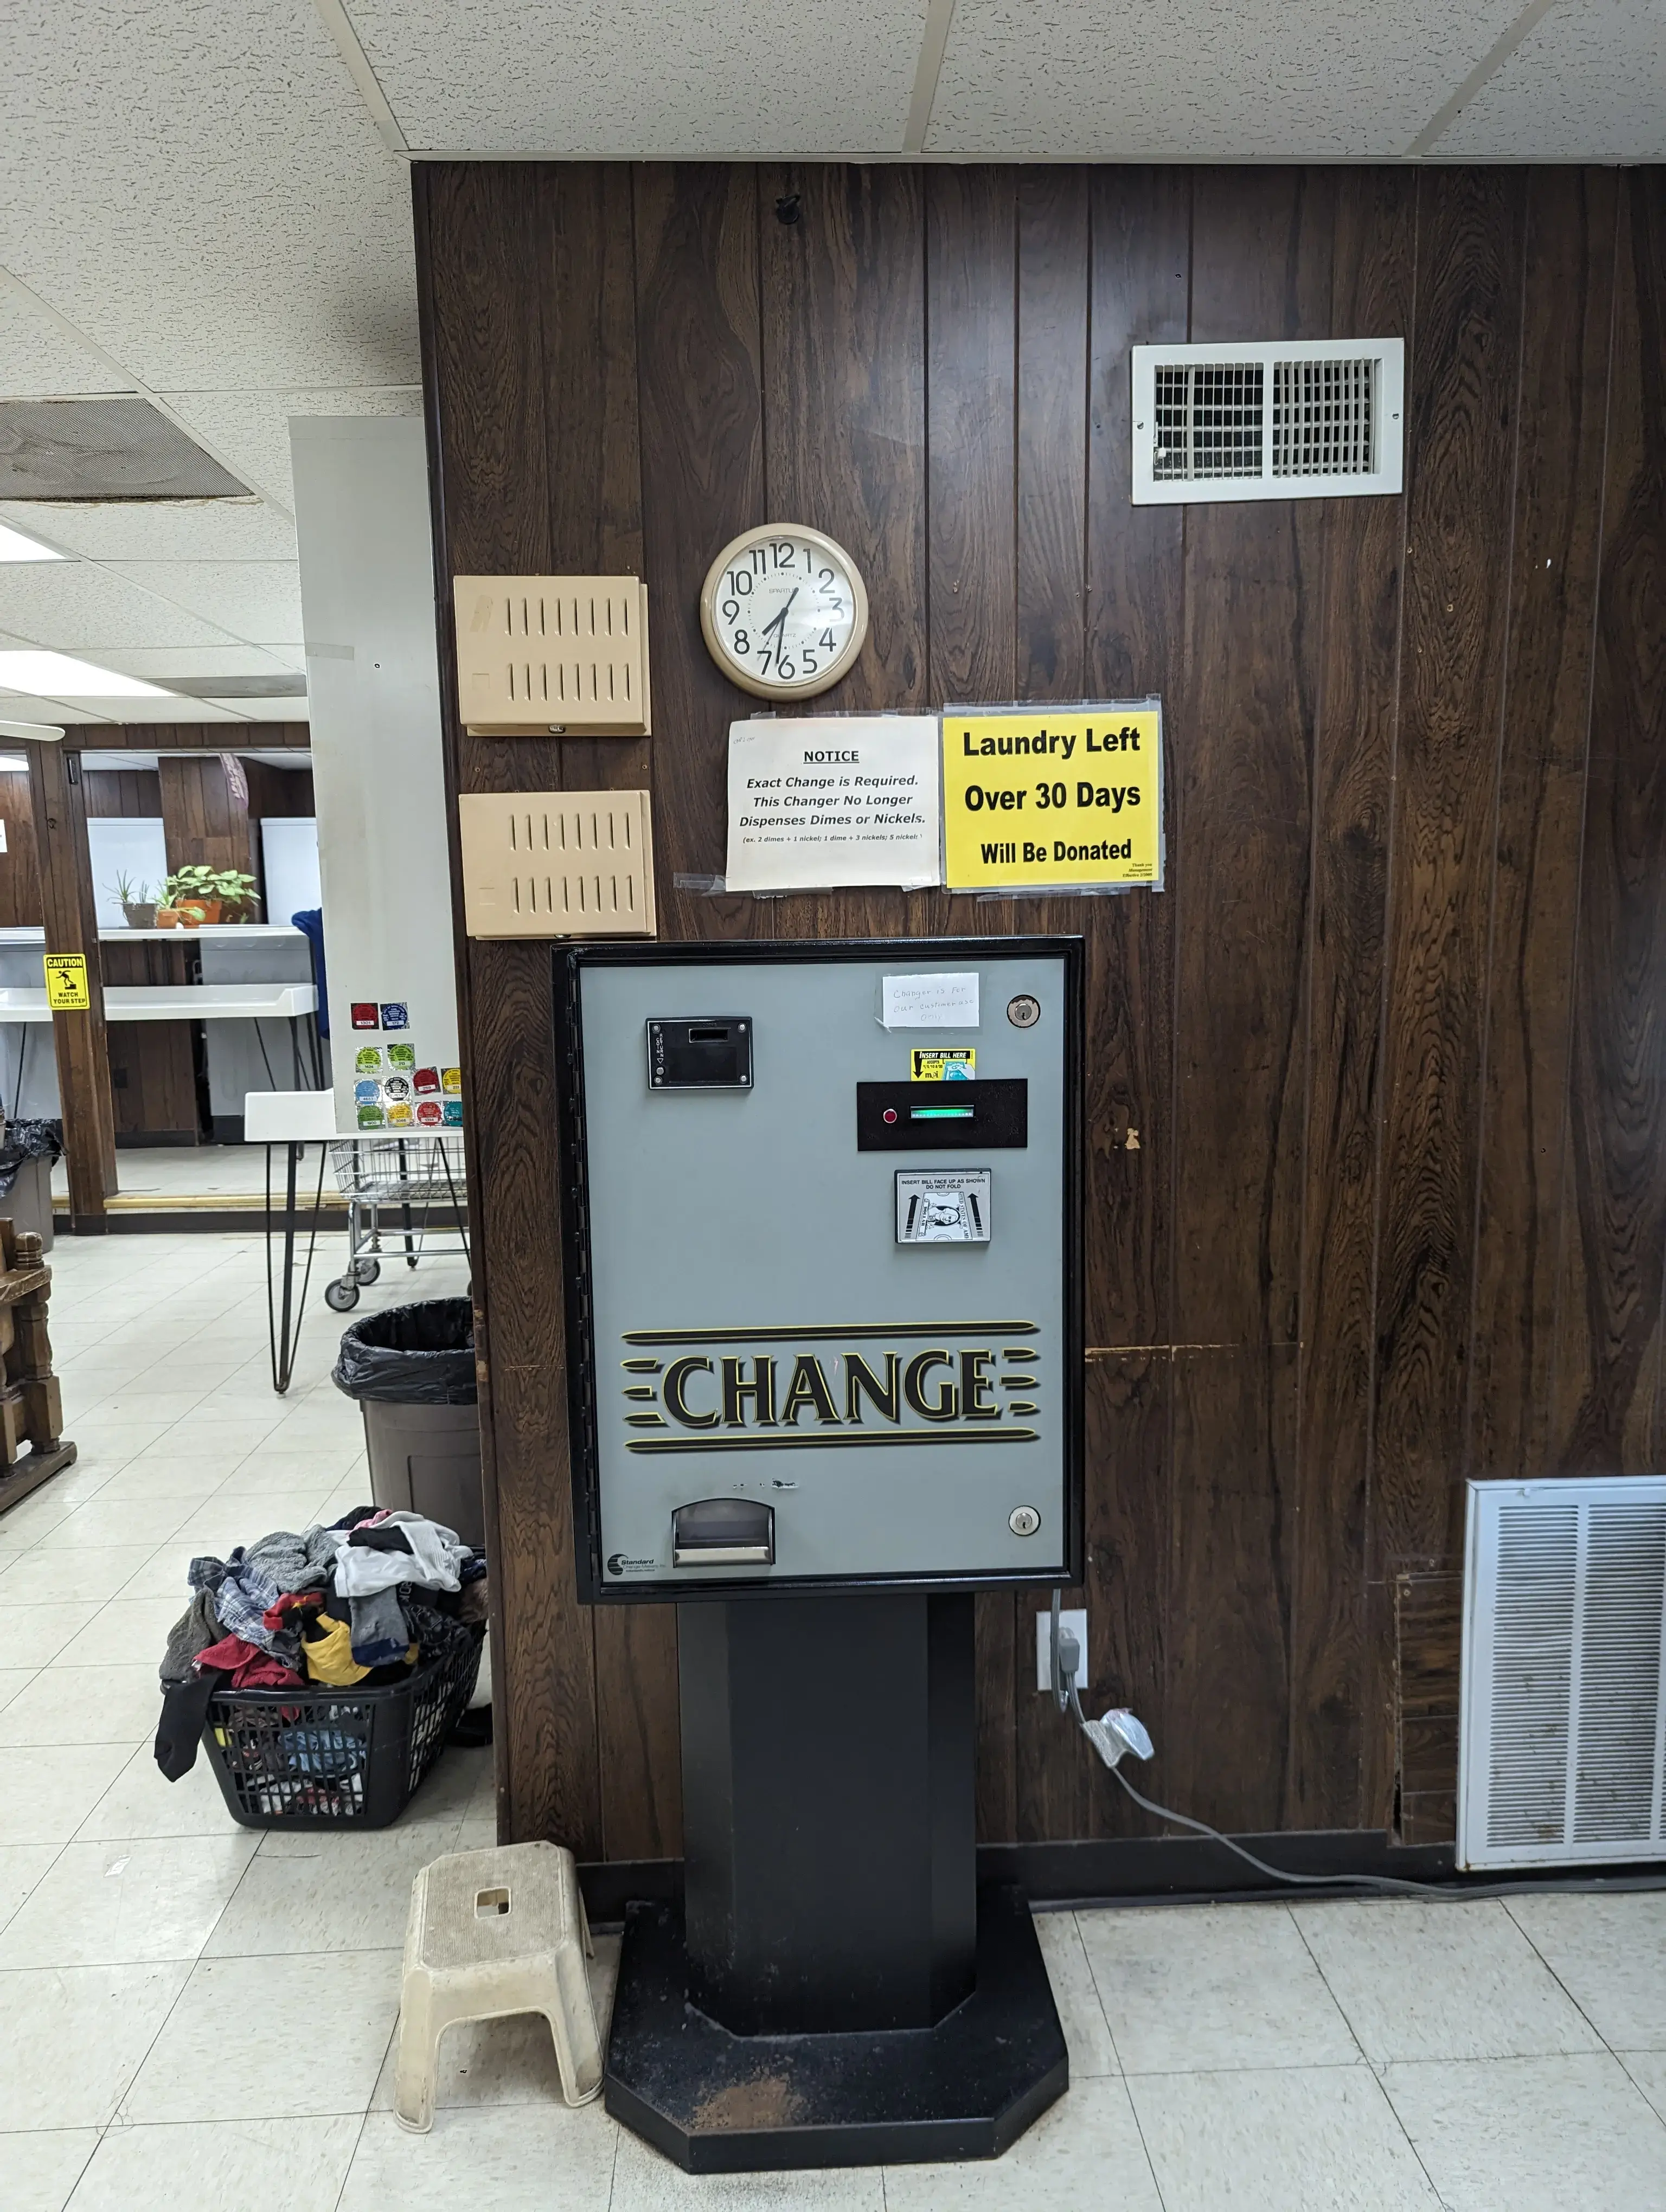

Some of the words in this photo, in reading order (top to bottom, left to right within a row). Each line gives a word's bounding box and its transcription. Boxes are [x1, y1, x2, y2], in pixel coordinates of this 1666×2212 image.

[749, 549, 766, 575] 11
[769, 542, 796, 569] 12
[803, 548, 812, 574] 1
[727, 570, 753, 596] 10
[818, 568, 835, 594] 2
[722, 600, 740, 625] 9
[829, 597, 844, 622] 3
[734, 629, 750, 655] 8
[818, 627, 837, 652] 4
[757, 651, 772, 676] 7
[778, 654, 796, 680] 6
[802, 649, 818, 674] 5
[963, 730, 1077, 760] Laundry
[1085, 726, 1140, 753] Left
[803, 750, 860, 764] NOTICE
[747, 778, 782, 789] Exact
[785, 776, 835, 789] Change
[838, 777, 850, 787] is
[854, 775, 919, 788] Required.
[753, 797, 779, 807] This
[783, 795, 840, 808] Changer
[843, 795, 862, 806] No
[866, 794, 913, 807] Longer
[965, 785, 1027, 812] Over
[1035, 782, 1067, 809] 30
[1077, 781, 1140, 814] Days
[739, 816, 806, 828] Dispenses
[810, 814, 852, 825] Dimes
[855, 815, 870, 825] or
[874, 813, 926, 824] Nickels.
[981, 843, 1016, 864] Will
[1023, 841, 1047, 863] Be
[1053, 838, 1132, 862] Donated
[47, 958, 82, 967] CAUTION
[894, 990, 931, 1000] Changer
[937, 986, 945, 994] is
[925, 1071, 939, 1079] mei
[662, 1348, 999, 1427] CHANGE
